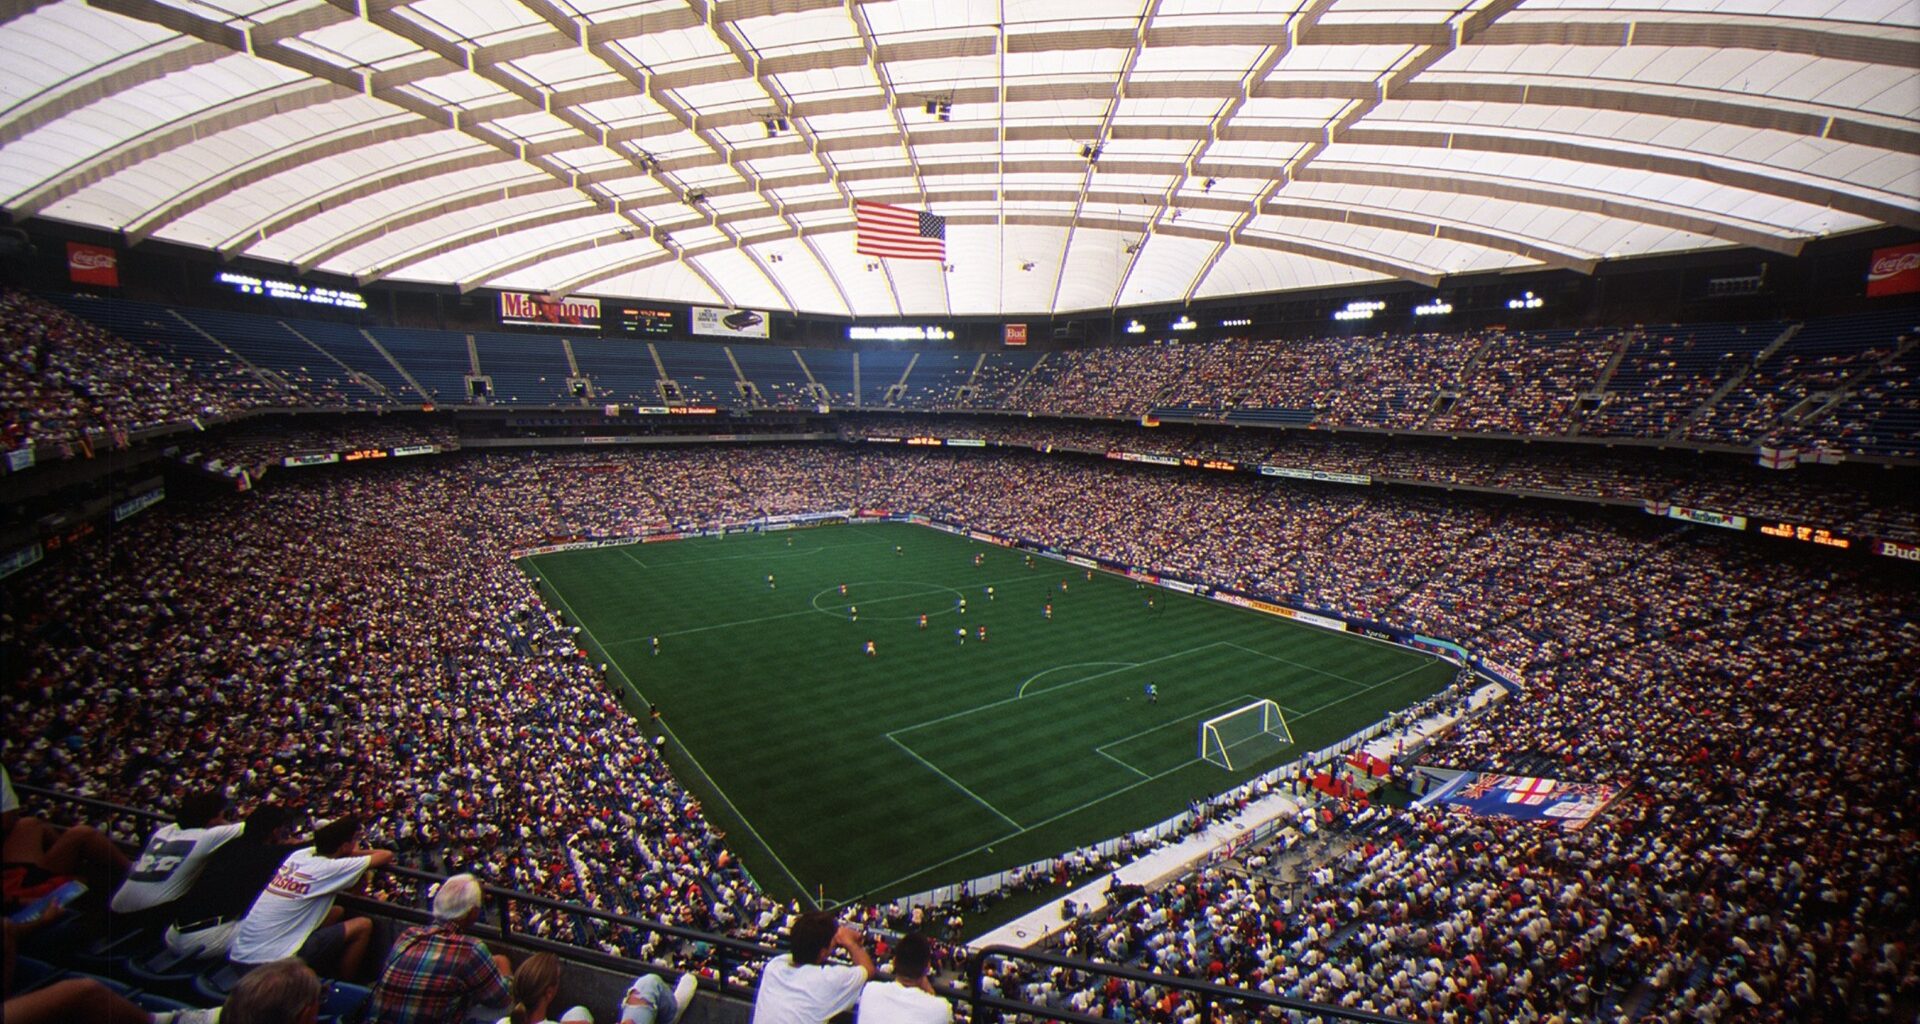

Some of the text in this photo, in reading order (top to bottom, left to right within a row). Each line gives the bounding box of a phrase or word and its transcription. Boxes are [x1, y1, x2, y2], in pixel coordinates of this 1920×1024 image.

[1007, 328, 1025, 337] Bud
[1366, 629, 1390, 640] Sprint
[1485, 660, 1524, 684] PONTIAC
